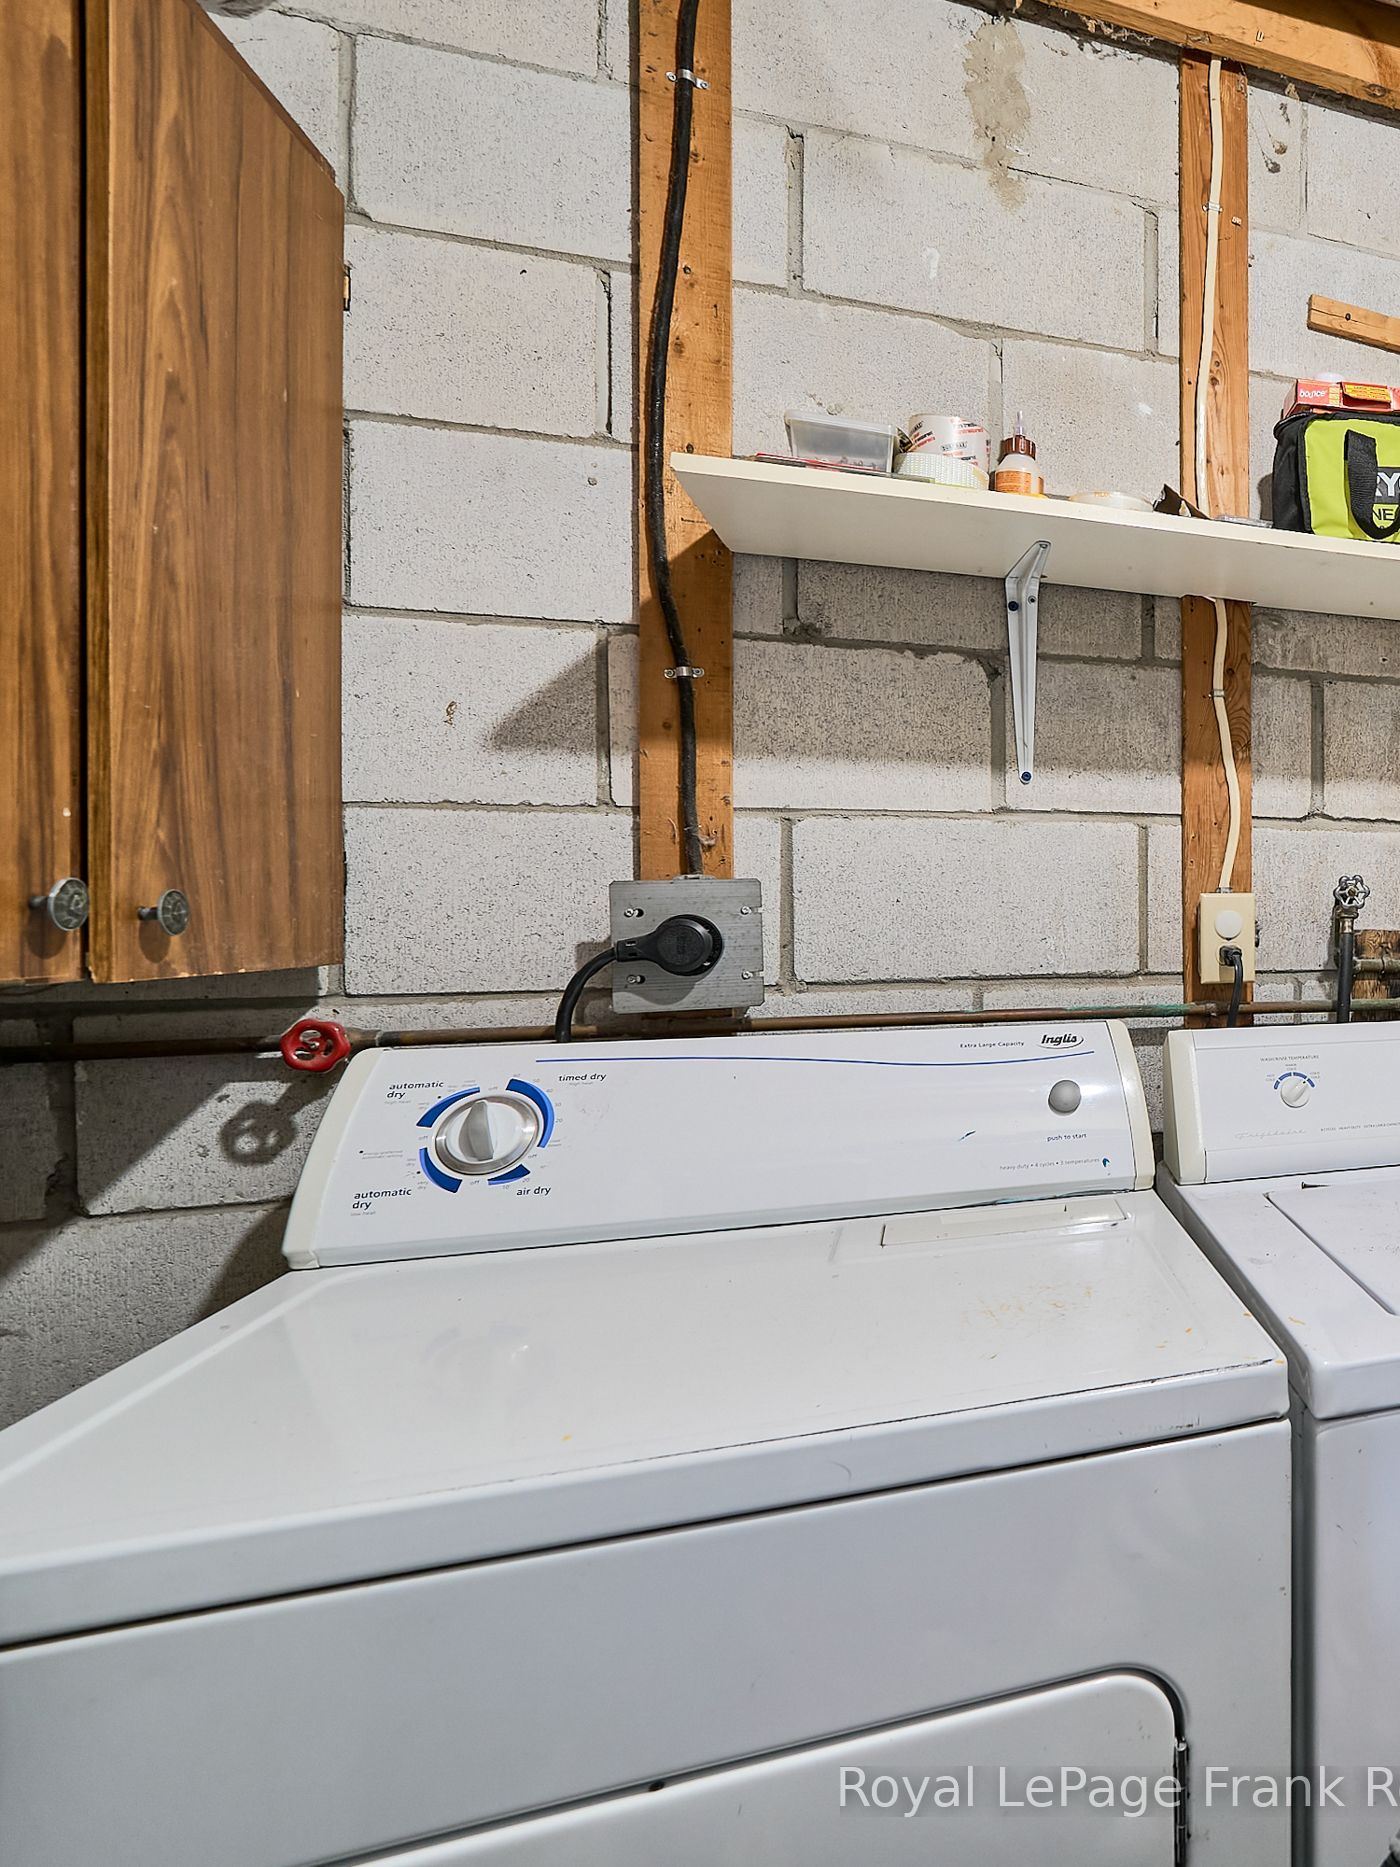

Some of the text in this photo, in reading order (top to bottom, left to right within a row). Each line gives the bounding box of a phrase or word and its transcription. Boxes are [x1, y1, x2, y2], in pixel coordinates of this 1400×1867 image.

[1299, 388, 1326, 399] bounce
[1041, 1033, 1078, 1046] Inglis
[559, 1073, 607, 1082] timed dry
[389, 1081, 445, 1090] automatic
[387, 1091, 406, 1099] dry
[354, 1187, 412, 1199] automatic
[516, 1186, 552, 1196] air dry
[352, 1201, 372, 1210] dry
